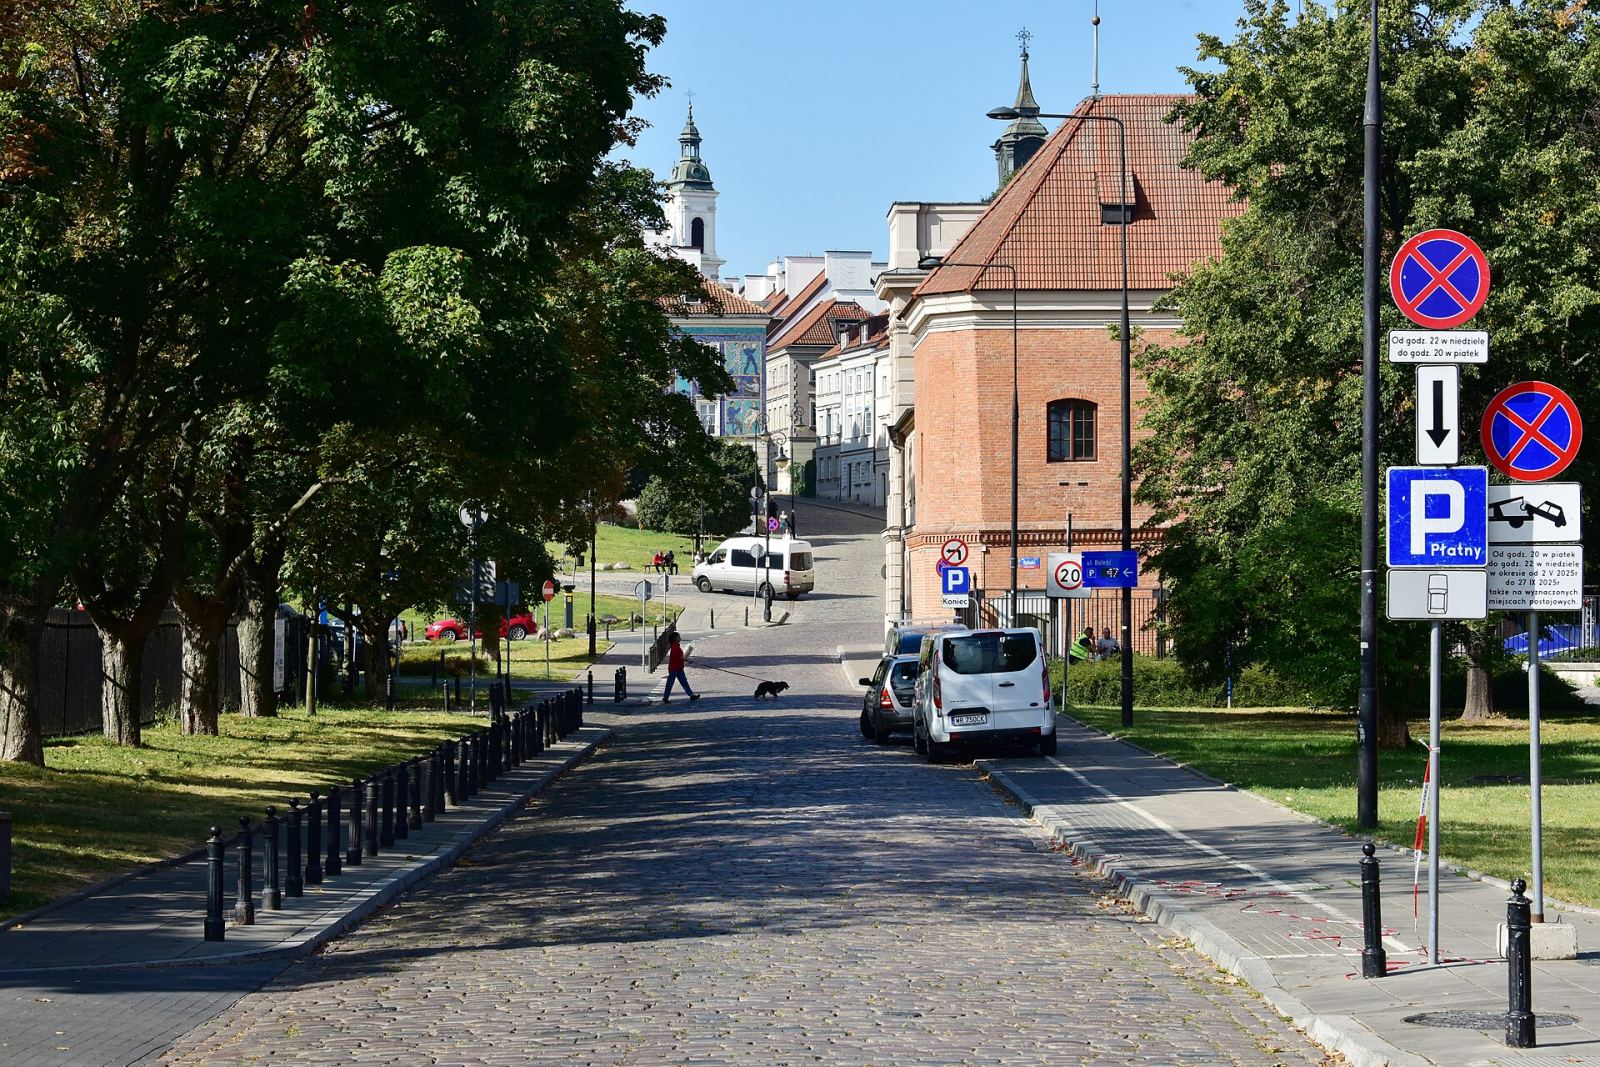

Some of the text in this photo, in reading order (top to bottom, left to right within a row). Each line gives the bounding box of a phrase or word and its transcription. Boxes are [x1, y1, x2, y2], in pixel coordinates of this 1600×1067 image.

[1391, 336, 1404, 344] Od
[1429, 336, 1439, 344] 22
[1397, 349, 1408, 357] do
[1410, 349, 1431, 358] godz.
[1433, 349, 1443, 357] 20
[1410, 480, 1465, 555] P
[1431, 542, 1481, 560] Płatny
[1060, 568, 1080, 583] 20
[1089, 569, 1095, 577] P
[1106, 567, 1119, 578] 47
[948, 570, 964, 591] P
[1524, 588, 1578, 597] wyznaczonych
[1488, 598, 1526, 606] miejscach
